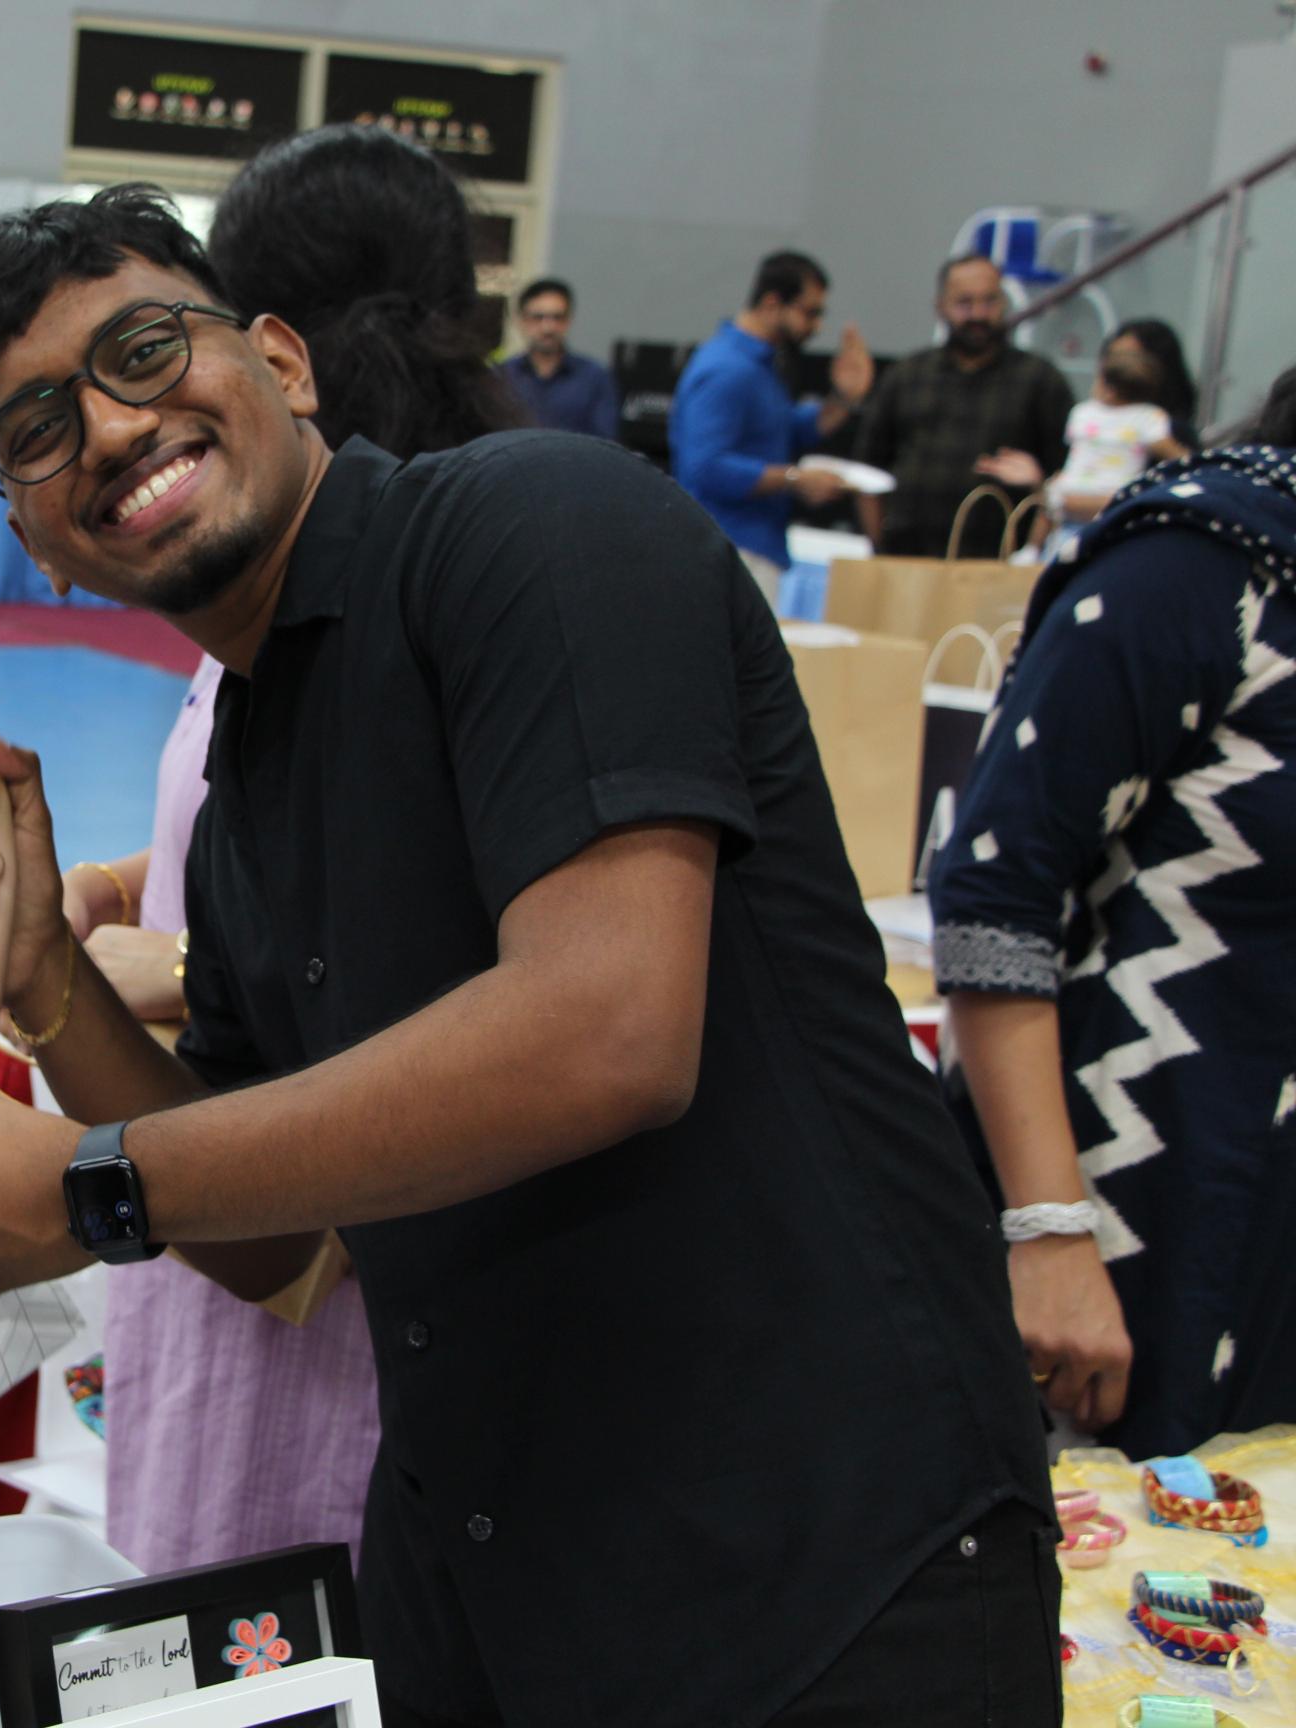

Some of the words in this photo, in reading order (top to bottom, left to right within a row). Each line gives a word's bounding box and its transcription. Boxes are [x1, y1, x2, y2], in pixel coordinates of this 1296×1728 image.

[58, 1656, 117, 1691] Commit
[117, 1656, 130, 1674] to
[129, 1647, 154, 1670] the
[162, 1638, 190, 1667] Lord
